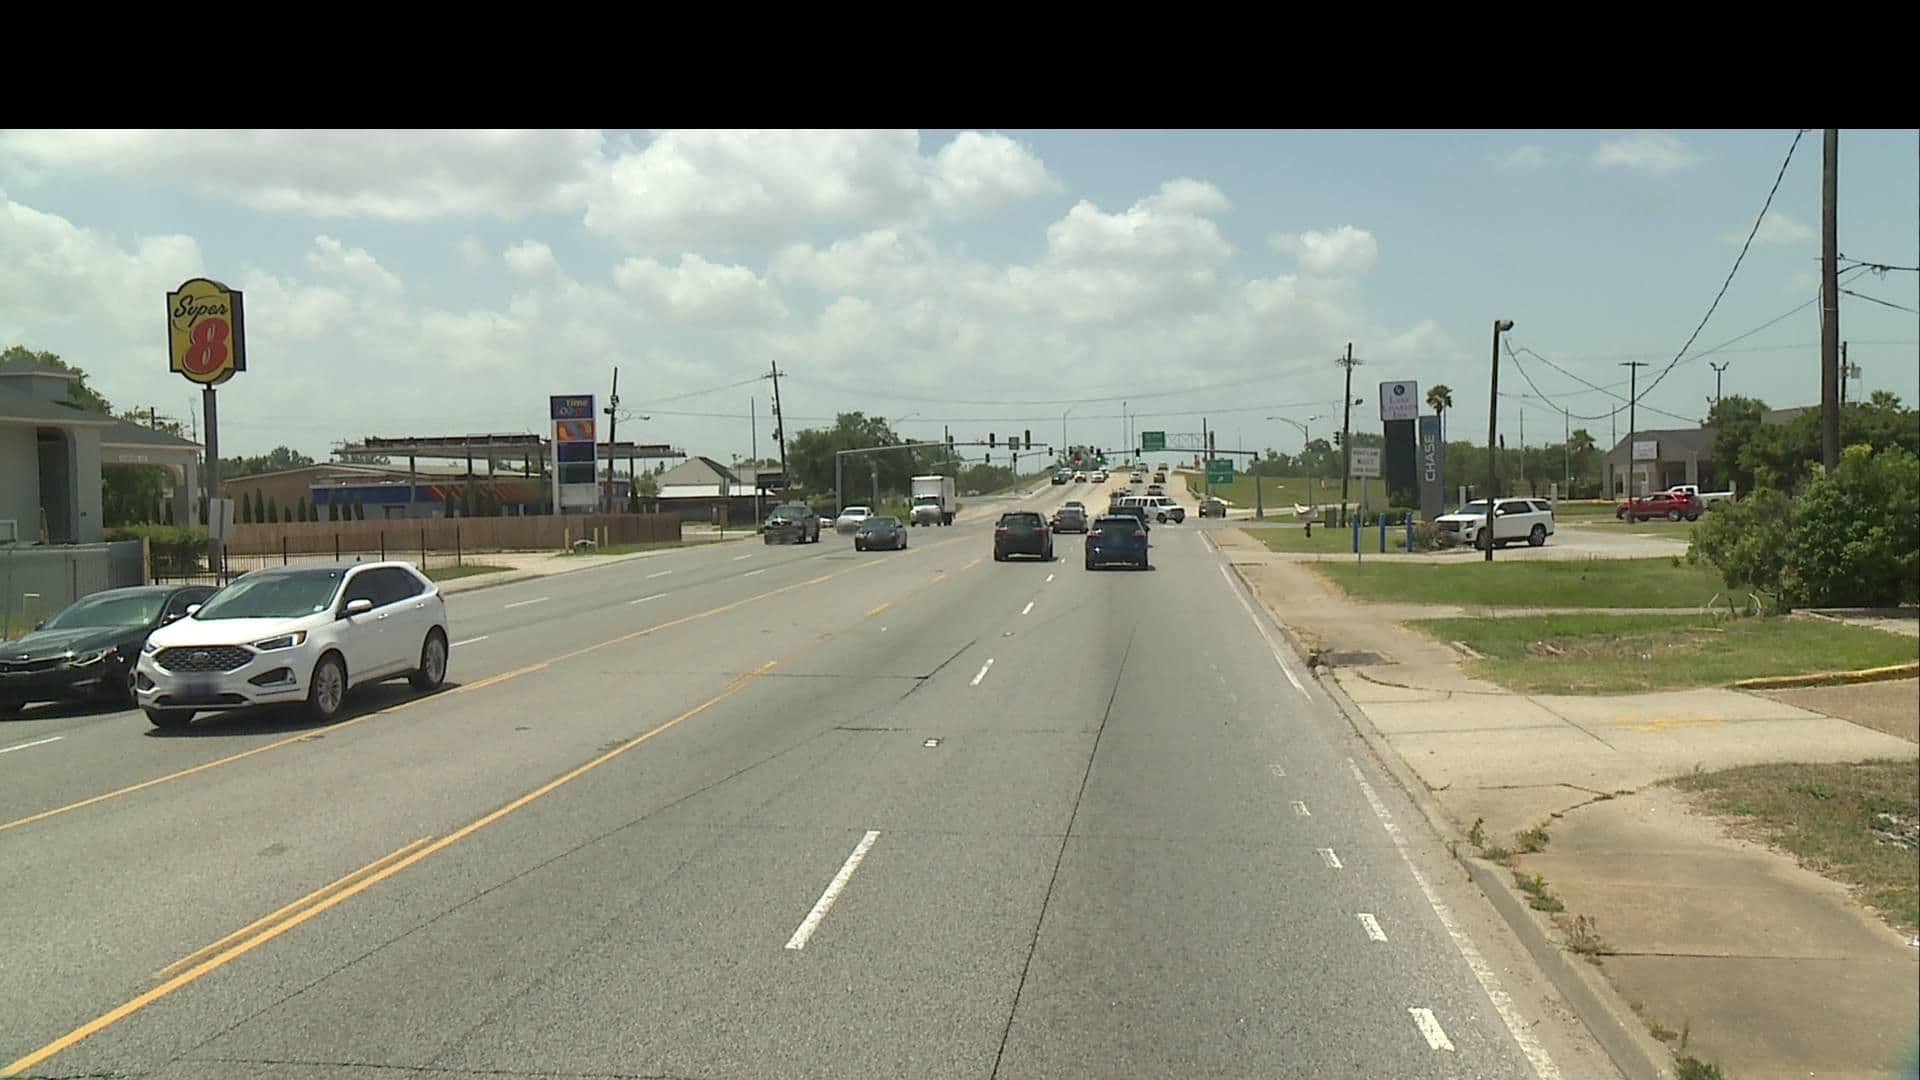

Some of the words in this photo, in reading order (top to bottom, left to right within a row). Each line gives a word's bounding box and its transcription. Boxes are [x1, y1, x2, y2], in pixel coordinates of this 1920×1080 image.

[174, 294, 228, 328] Super
[182, 316, 230, 374] 8
[1424, 433, 1437, 482] CHASE
